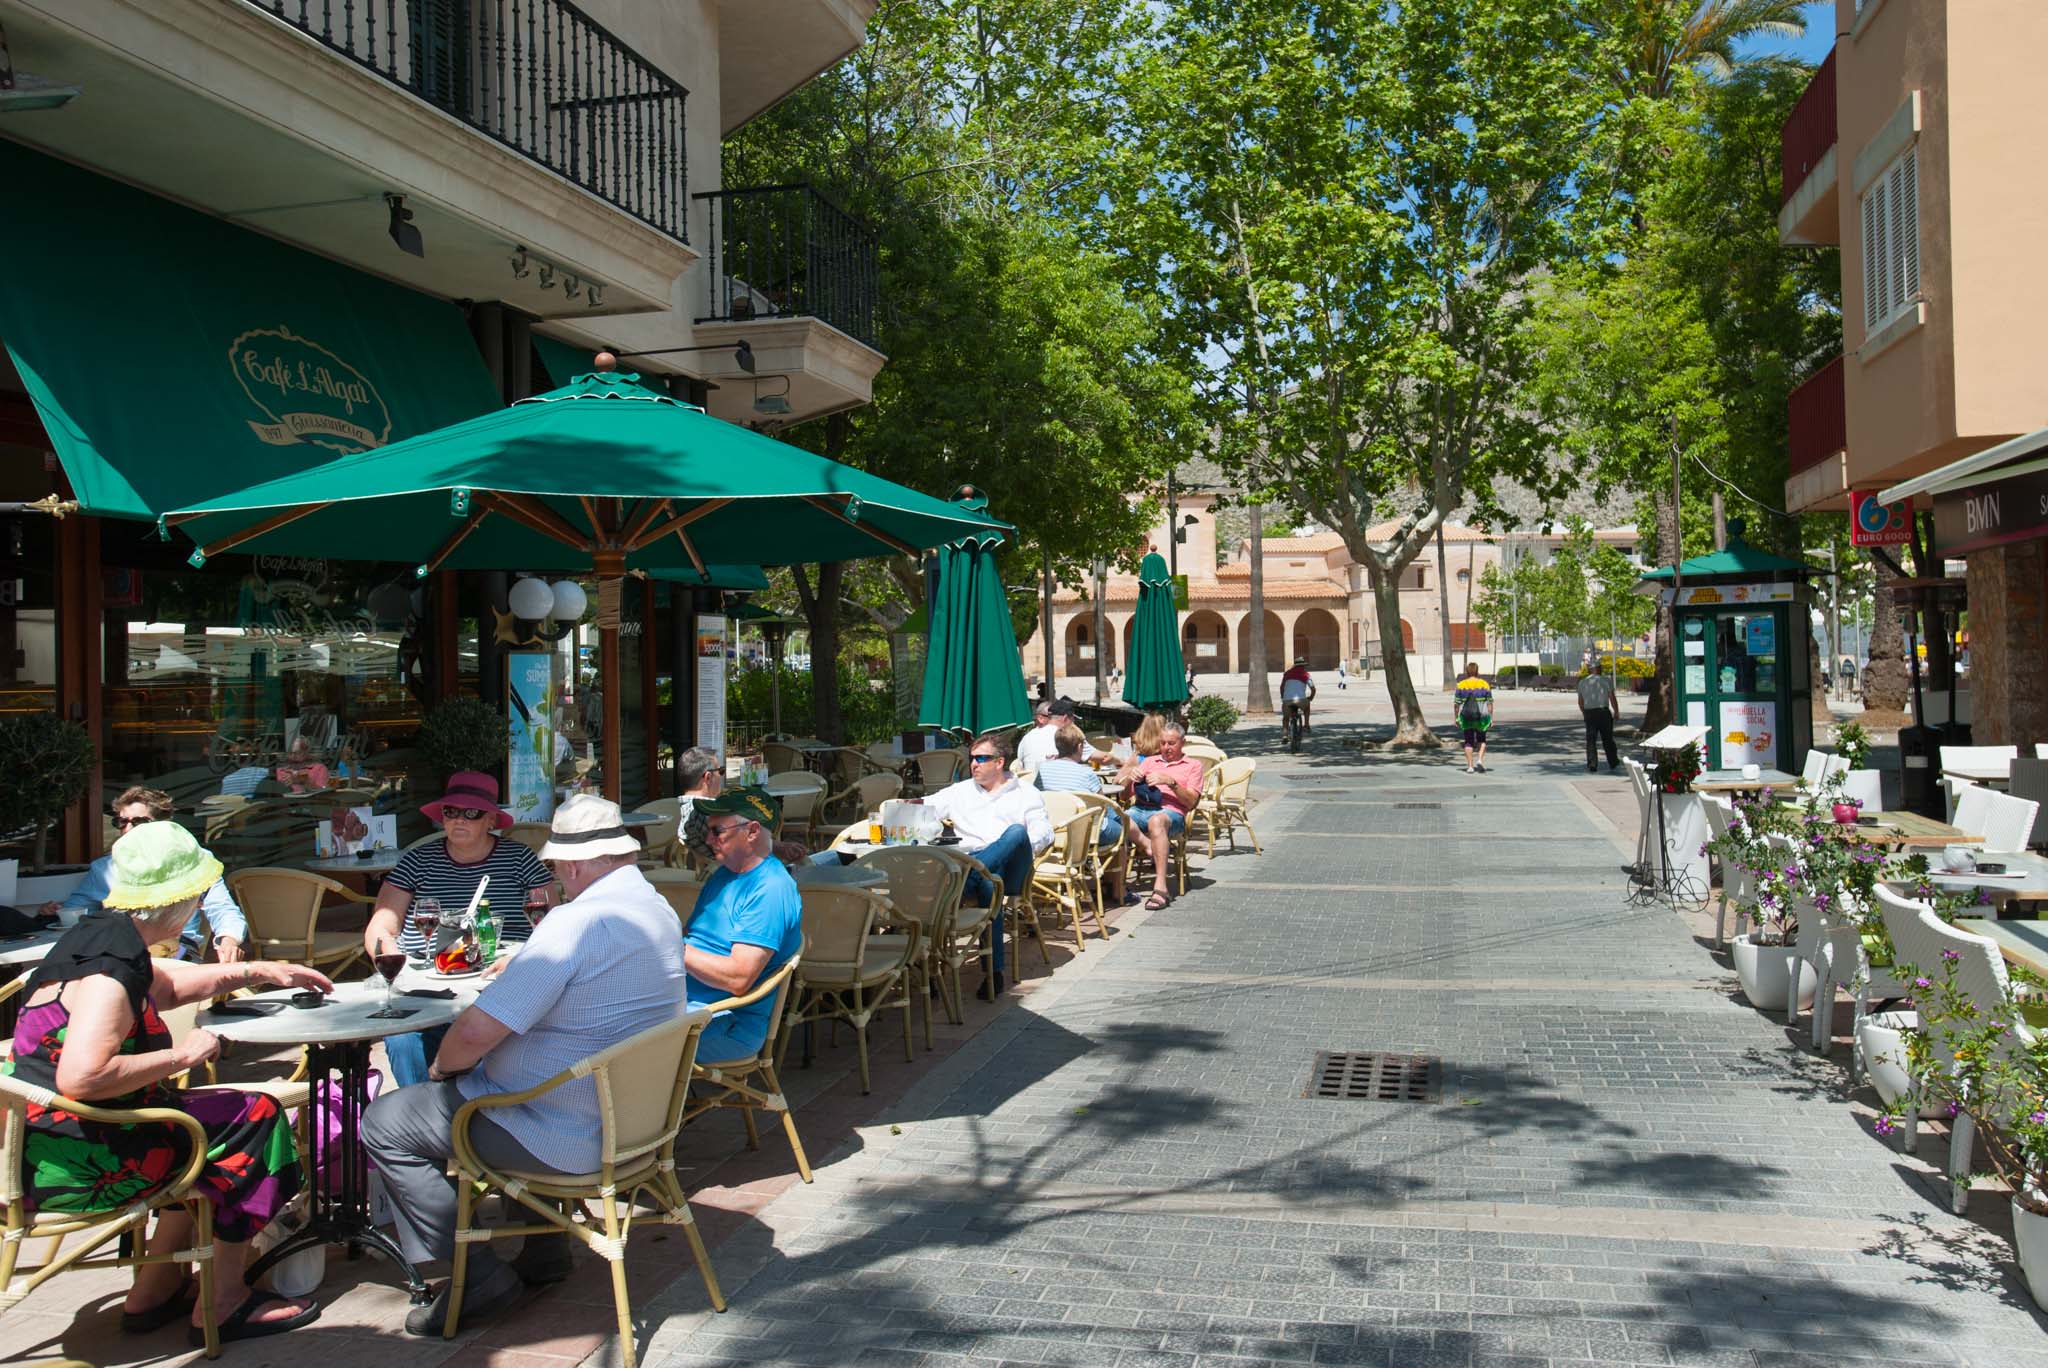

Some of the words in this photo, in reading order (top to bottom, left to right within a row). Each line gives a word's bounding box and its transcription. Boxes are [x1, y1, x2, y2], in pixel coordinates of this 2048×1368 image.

[242, 350, 295, 397] Café
[1966, 490, 2001, 533] BMN
[1857, 533, 1883, 543] EURO
[1884, 531, 1912, 542] 6000
